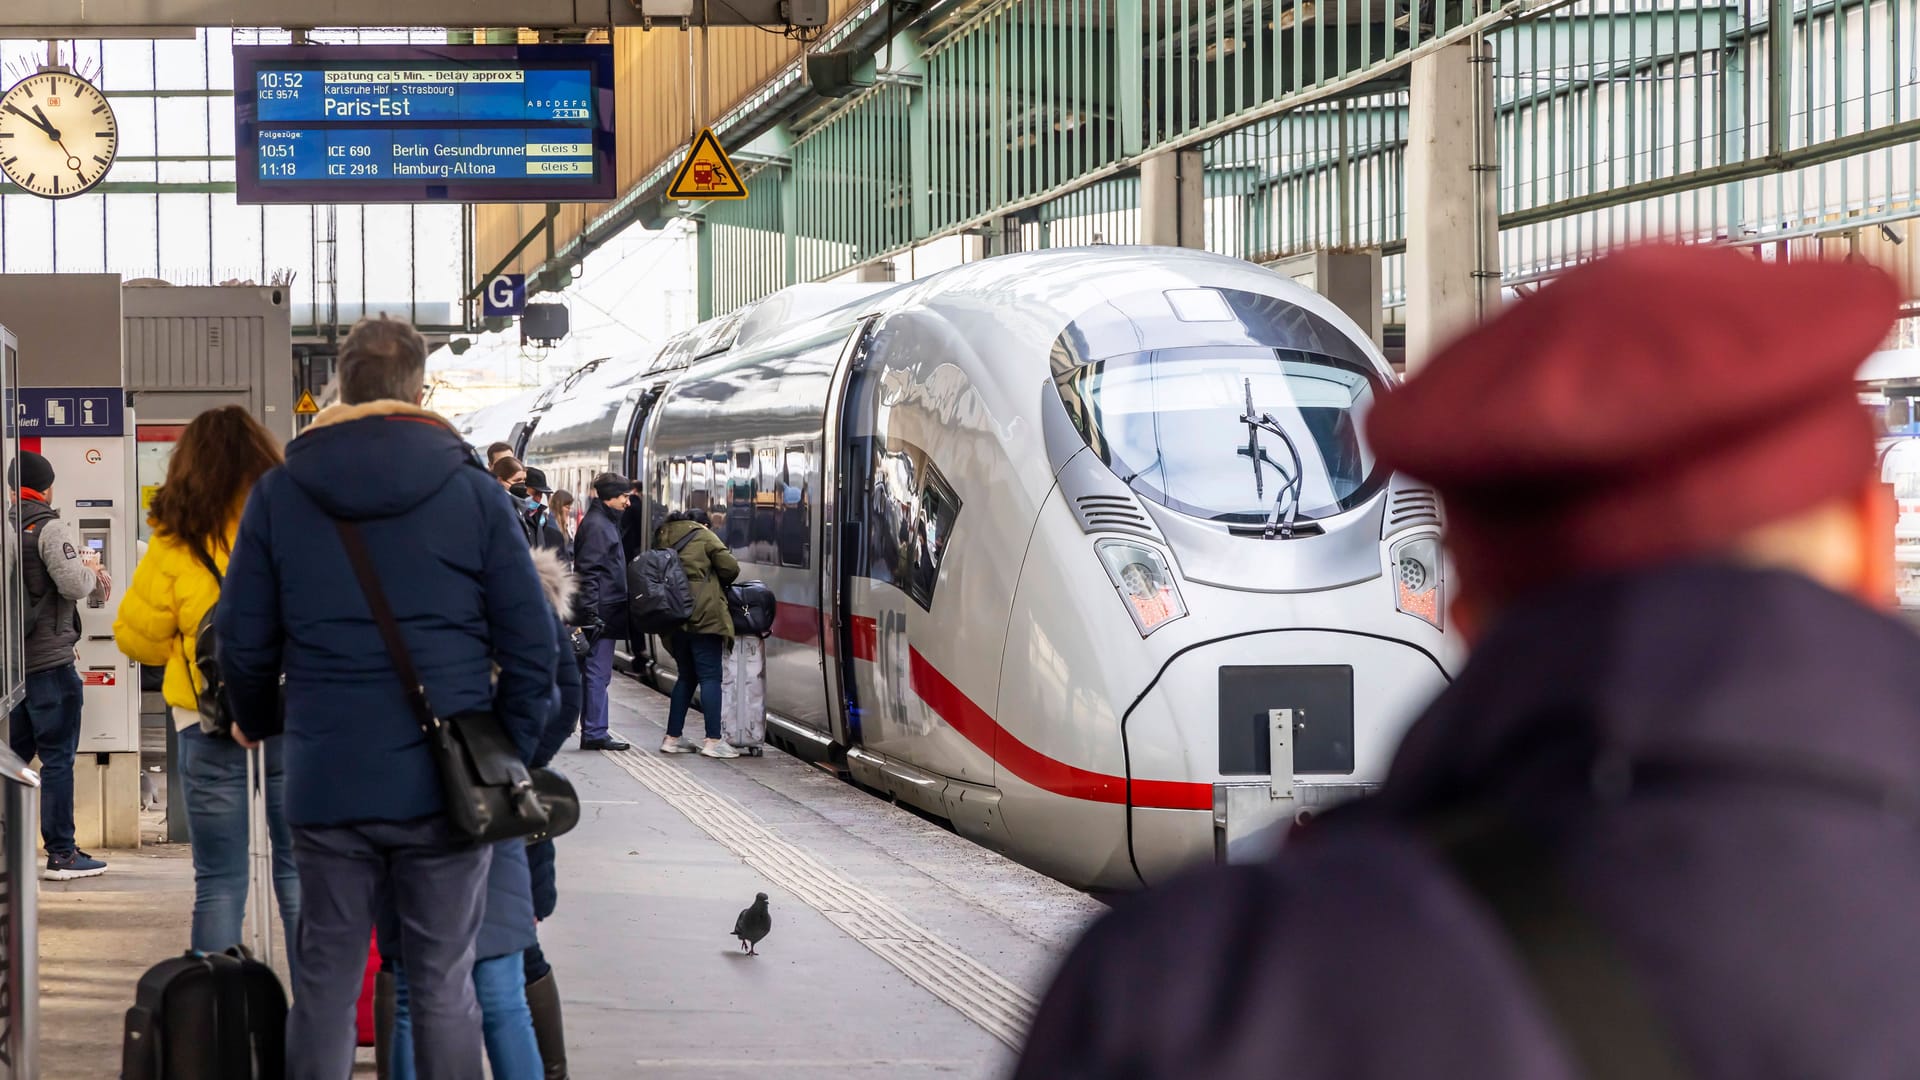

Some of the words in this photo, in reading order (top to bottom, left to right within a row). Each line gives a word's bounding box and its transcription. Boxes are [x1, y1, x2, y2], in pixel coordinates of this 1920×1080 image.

[260, 73, 303, 88] 10:52
[377, 72, 390, 80] ca
[394, 71, 400, 80] 5
[403, 71, 425, 80] Min.
[436, 71, 468, 81] Delay
[472, 72, 512, 82] approx
[515, 71, 522, 80] 5
[259, 90, 273, 99] ICE
[276, 90, 299, 99] 9574
[324, 85, 371, 95] Karlsruhe
[373, 85, 390, 95] Hbf
[402, 85, 455, 96] Strasbourg
[325, 98, 410, 116] Paris-Est
[260, 145, 295, 157] 10:51
[328, 146, 346, 157] ICE
[350, 146, 371, 157] 690
[393, 144, 428, 156] Berlin
[540, 144, 568, 153] Gleis
[572, 144, 578, 153] 9
[260, 163, 296, 175] 11:18
[328, 164, 346, 175] ICE
[350, 164, 378, 175] 2918
[393, 163, 496, 177] Hamburg-Altona
[541, 162, 568, 171] Gleis
[572, 162, 578, 171] 5
[488, 275, 514, 308] G
[879, 609, 908, 725] ICE
